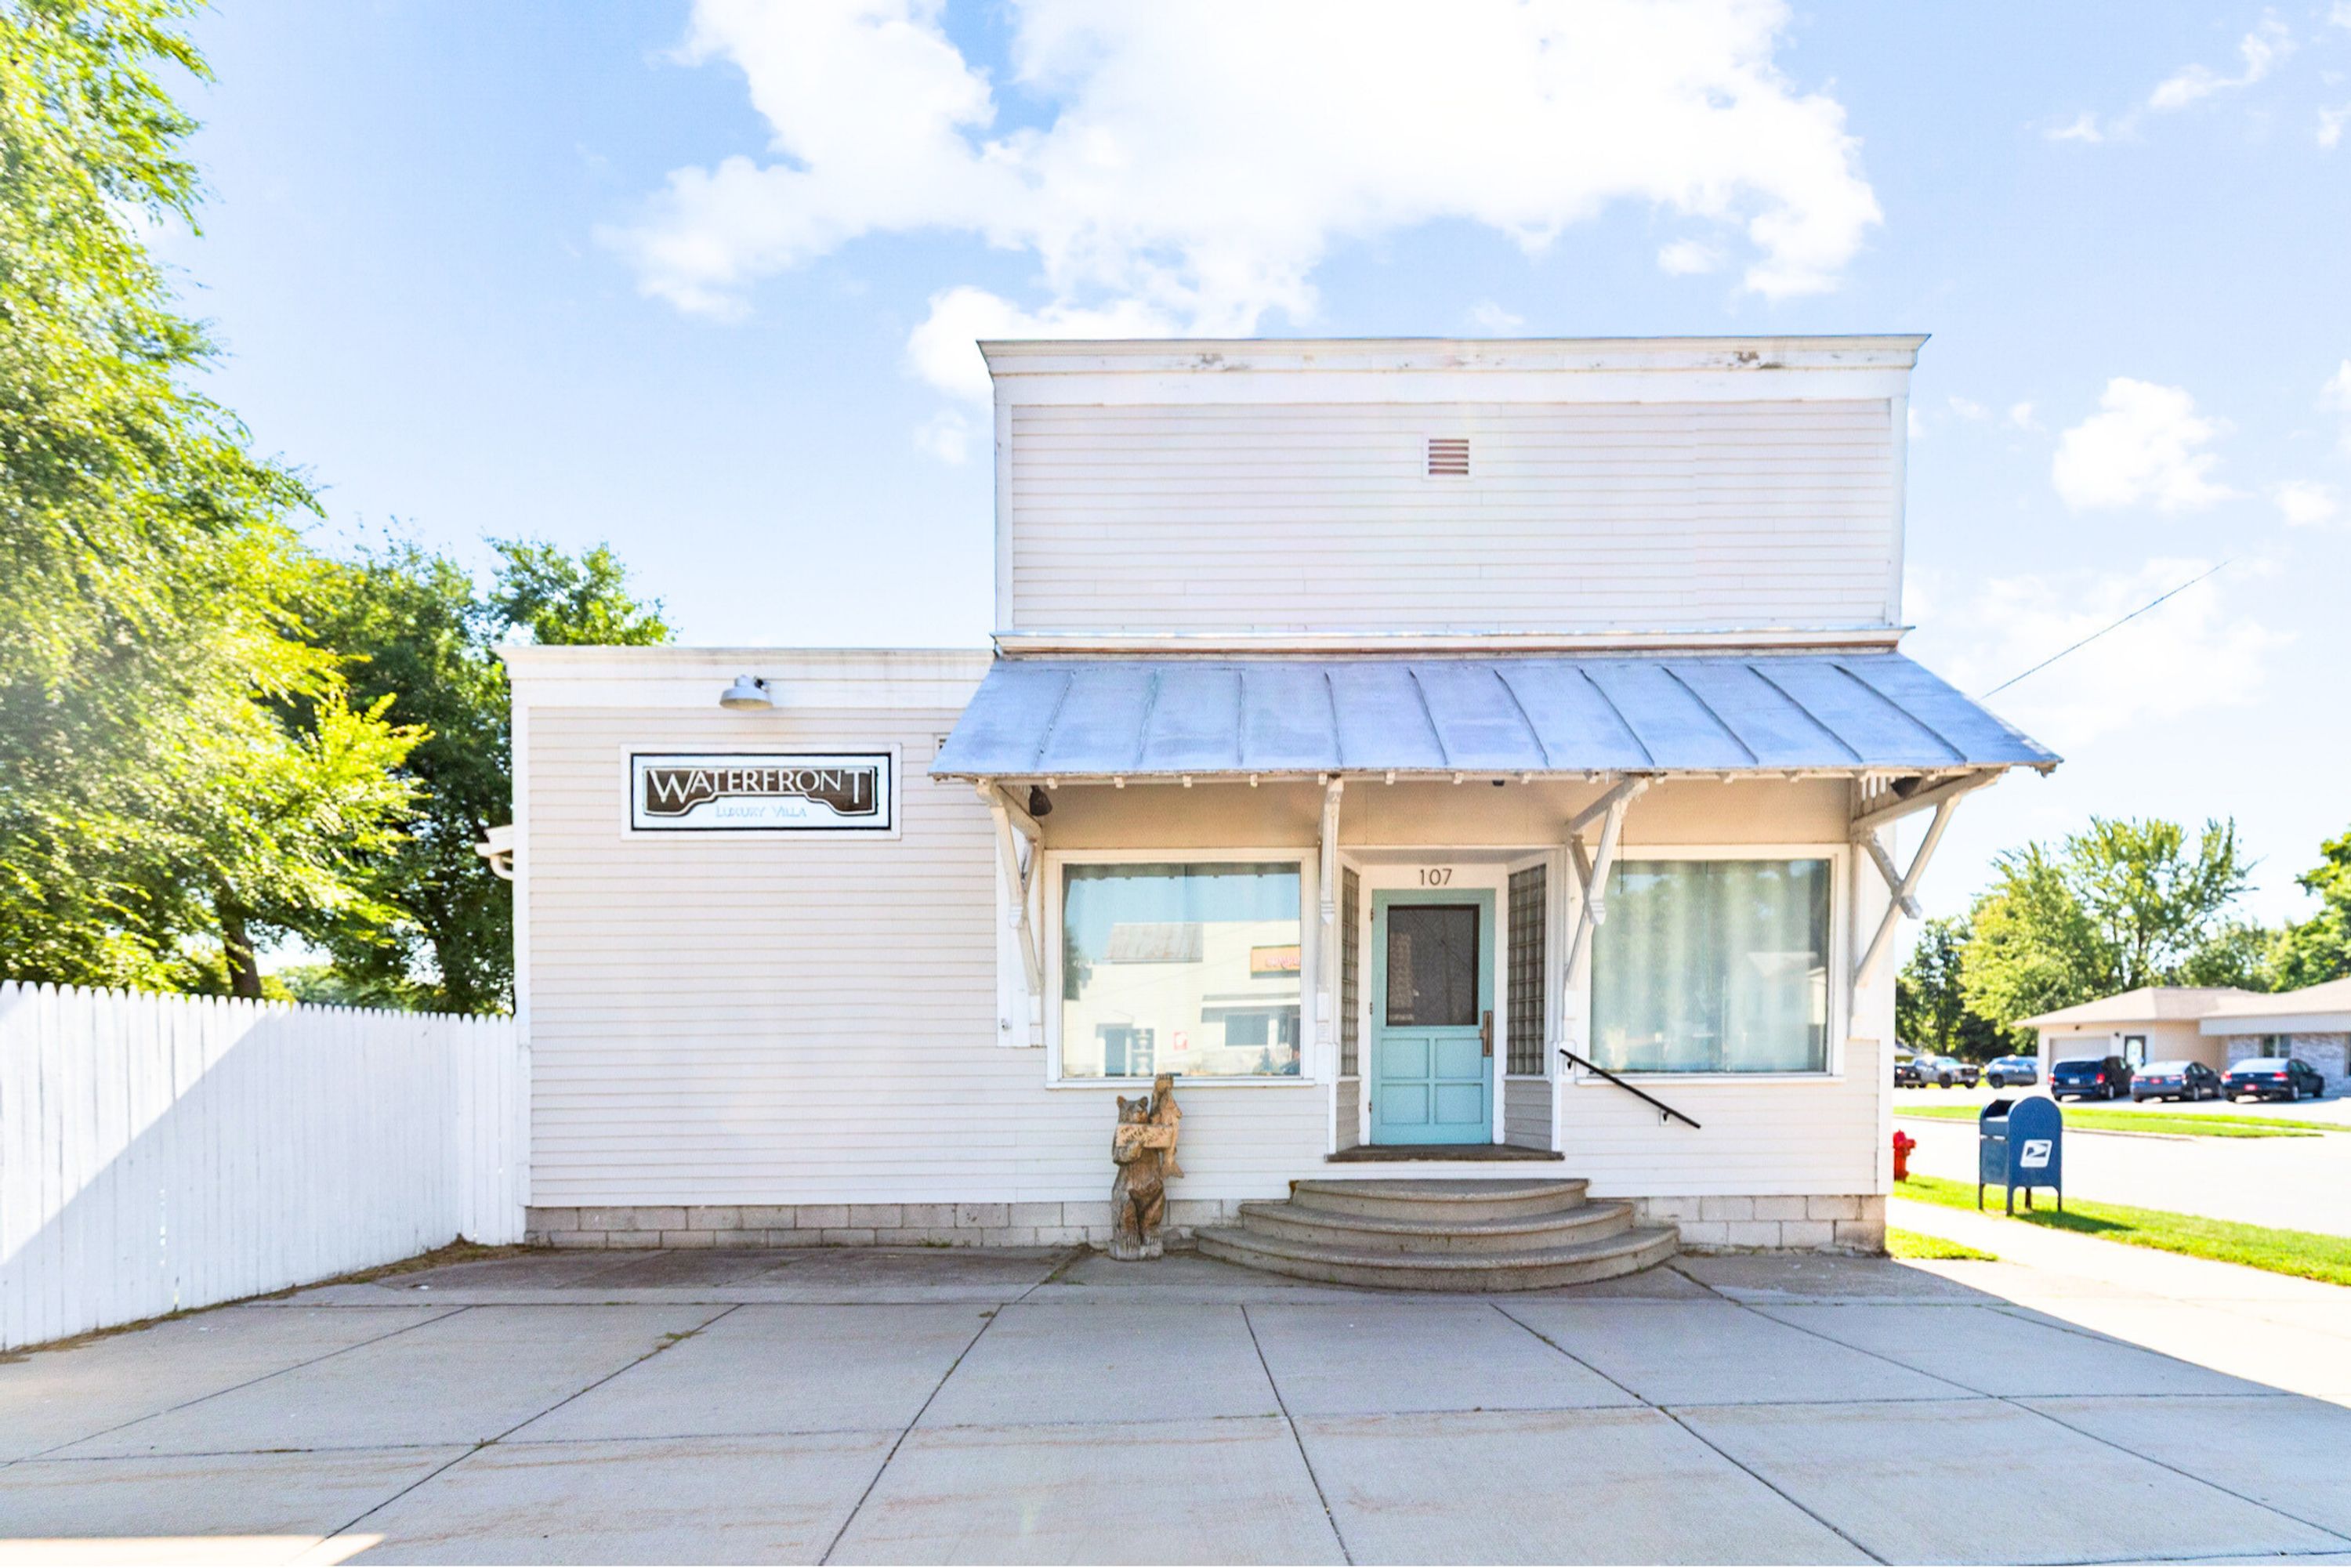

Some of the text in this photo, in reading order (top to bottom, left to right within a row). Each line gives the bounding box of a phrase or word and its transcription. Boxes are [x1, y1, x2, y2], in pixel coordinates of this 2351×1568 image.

[649, 769, 871, 804] WATERFRONT
[715, 805, 807, 817] LUXURY VILLA
[1420, 868, 1452, 885] 107
